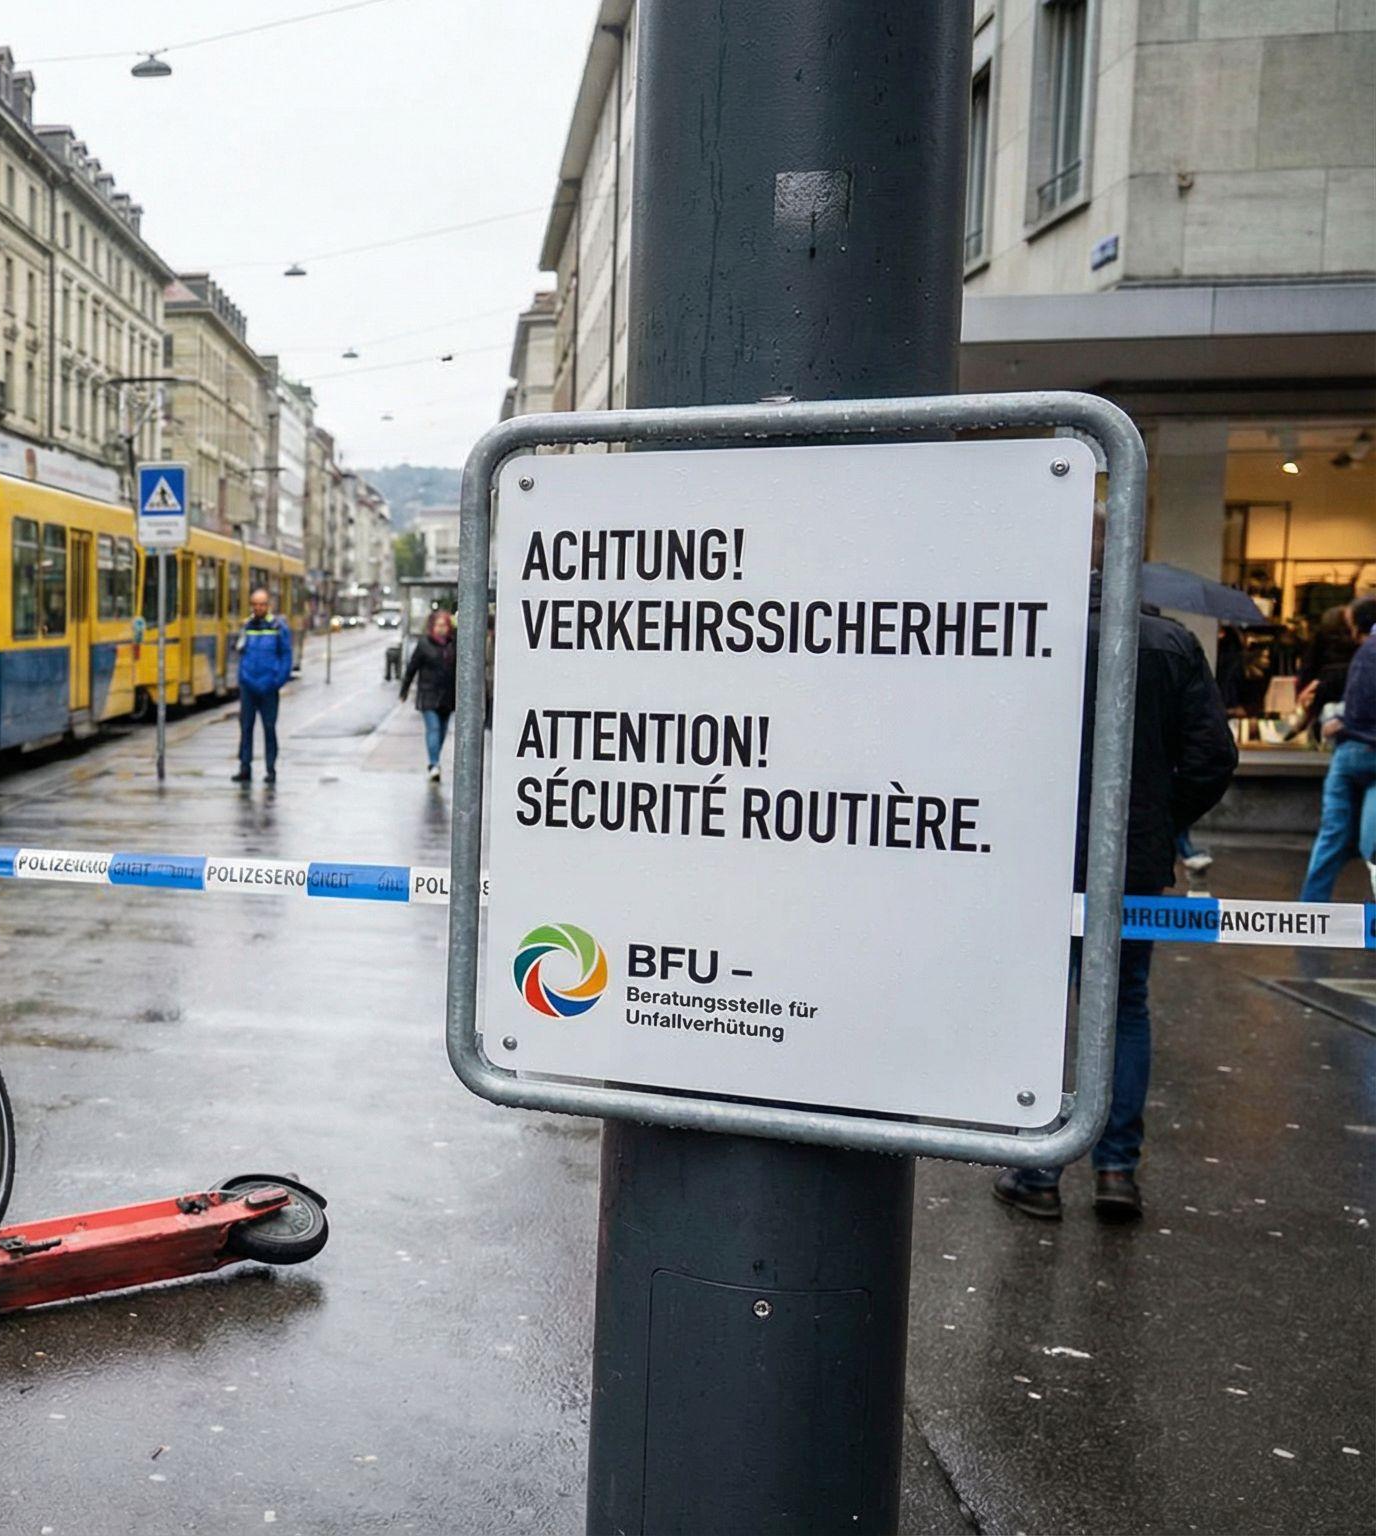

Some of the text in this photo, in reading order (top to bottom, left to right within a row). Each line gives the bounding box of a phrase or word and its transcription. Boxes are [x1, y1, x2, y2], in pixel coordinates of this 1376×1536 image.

[521, 528, 745, 581] ACHTUNG!
[521, 599, 1053, 658] VERKEHRSSICHERHEIT.
[516, 708, 770, 768] ATTENTION!
[516, 765, 991, 853] SÉCURITÉ ROUTIÈRE.
[628, 943, 719, 985] BFU
[625, 1008, 785, 1043] Unfallverhütung
[626, 986, 819, 1019] Beratungsstelle für
